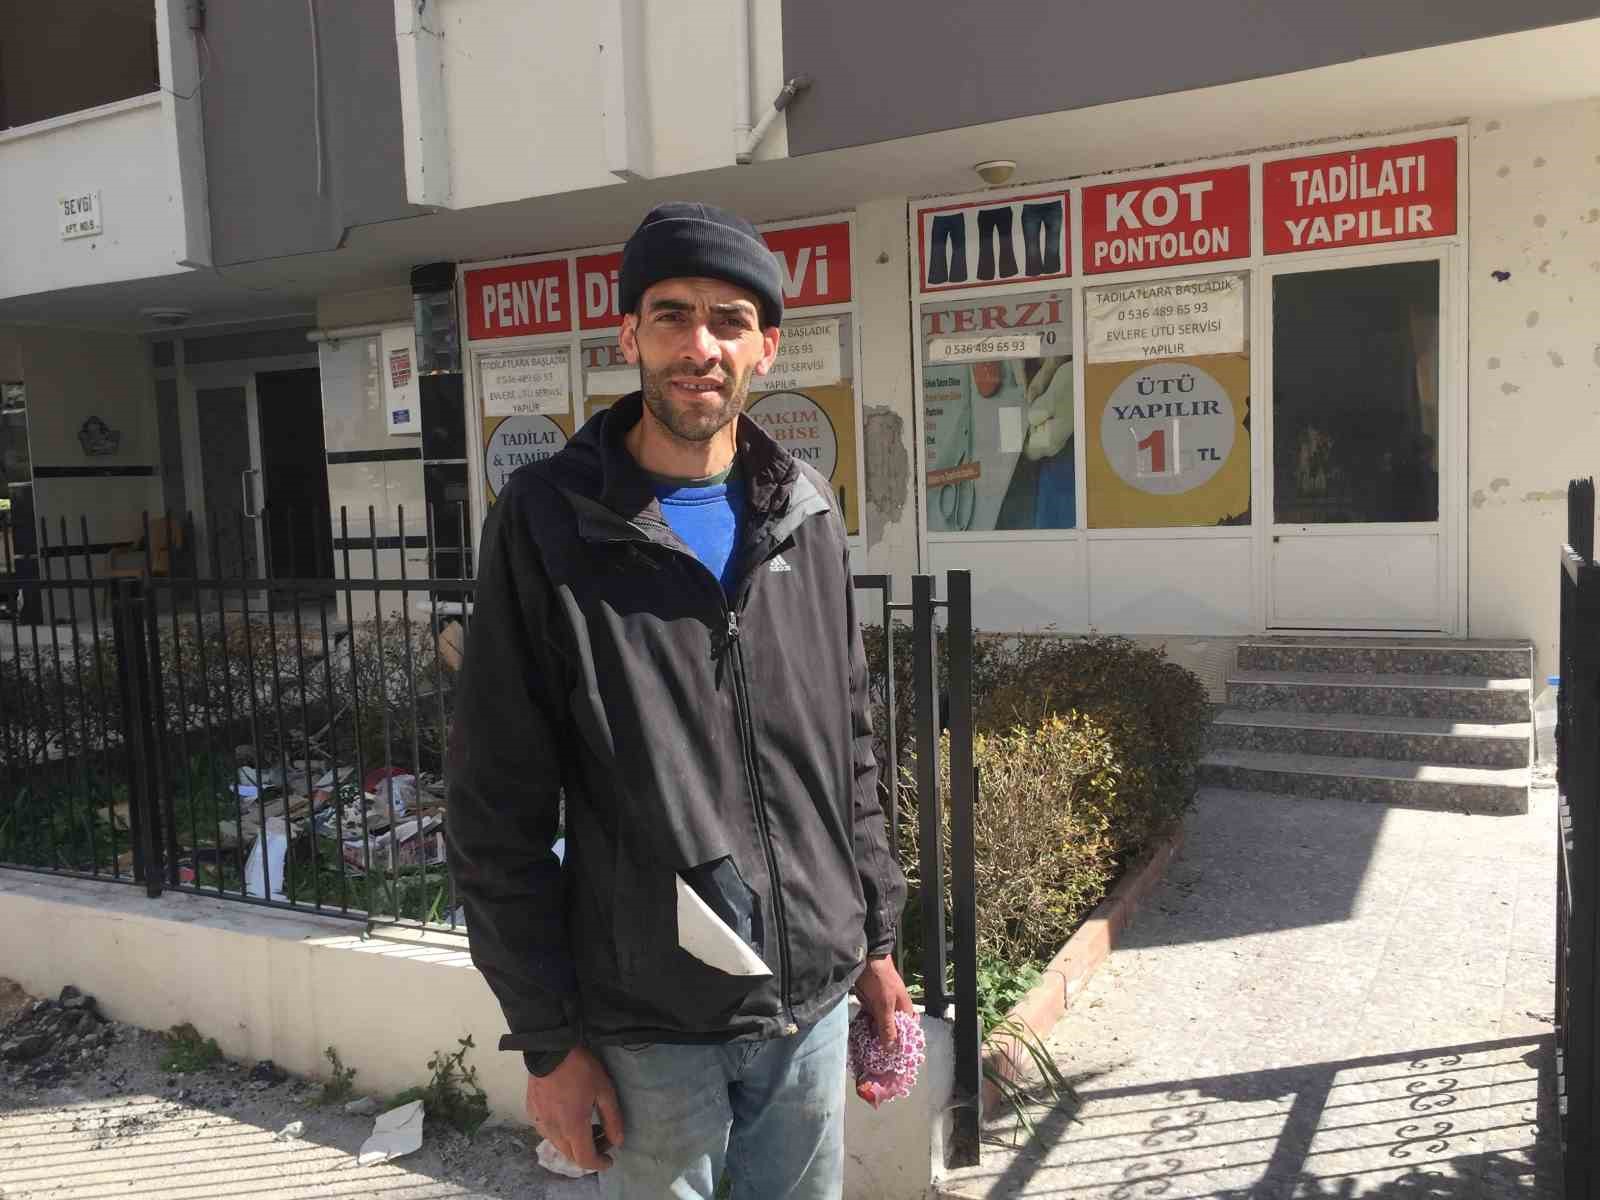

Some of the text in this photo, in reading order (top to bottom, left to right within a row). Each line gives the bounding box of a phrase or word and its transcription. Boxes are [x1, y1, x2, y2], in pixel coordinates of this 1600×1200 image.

[1290, 155, 1425, 207] TADİLATI
[1106, 180, 1213, 232] KOT
[1284, 204, 1435, 246] YAPILIR
[1094, 226, 1229, 266] PONTOLON
[482, 276, 561, 329] PENYE
[921, 294, 1063, 335] TERZİ
[1136, 373, 1195, 396] ÜTÜ
[1112, 400, 1222, 420] YAPILIR
[501, 428, 557, 446] TADİLAT
[776, 425, 817, 439] BİSE
[1137, 430, 1221, 472] 1 TL
